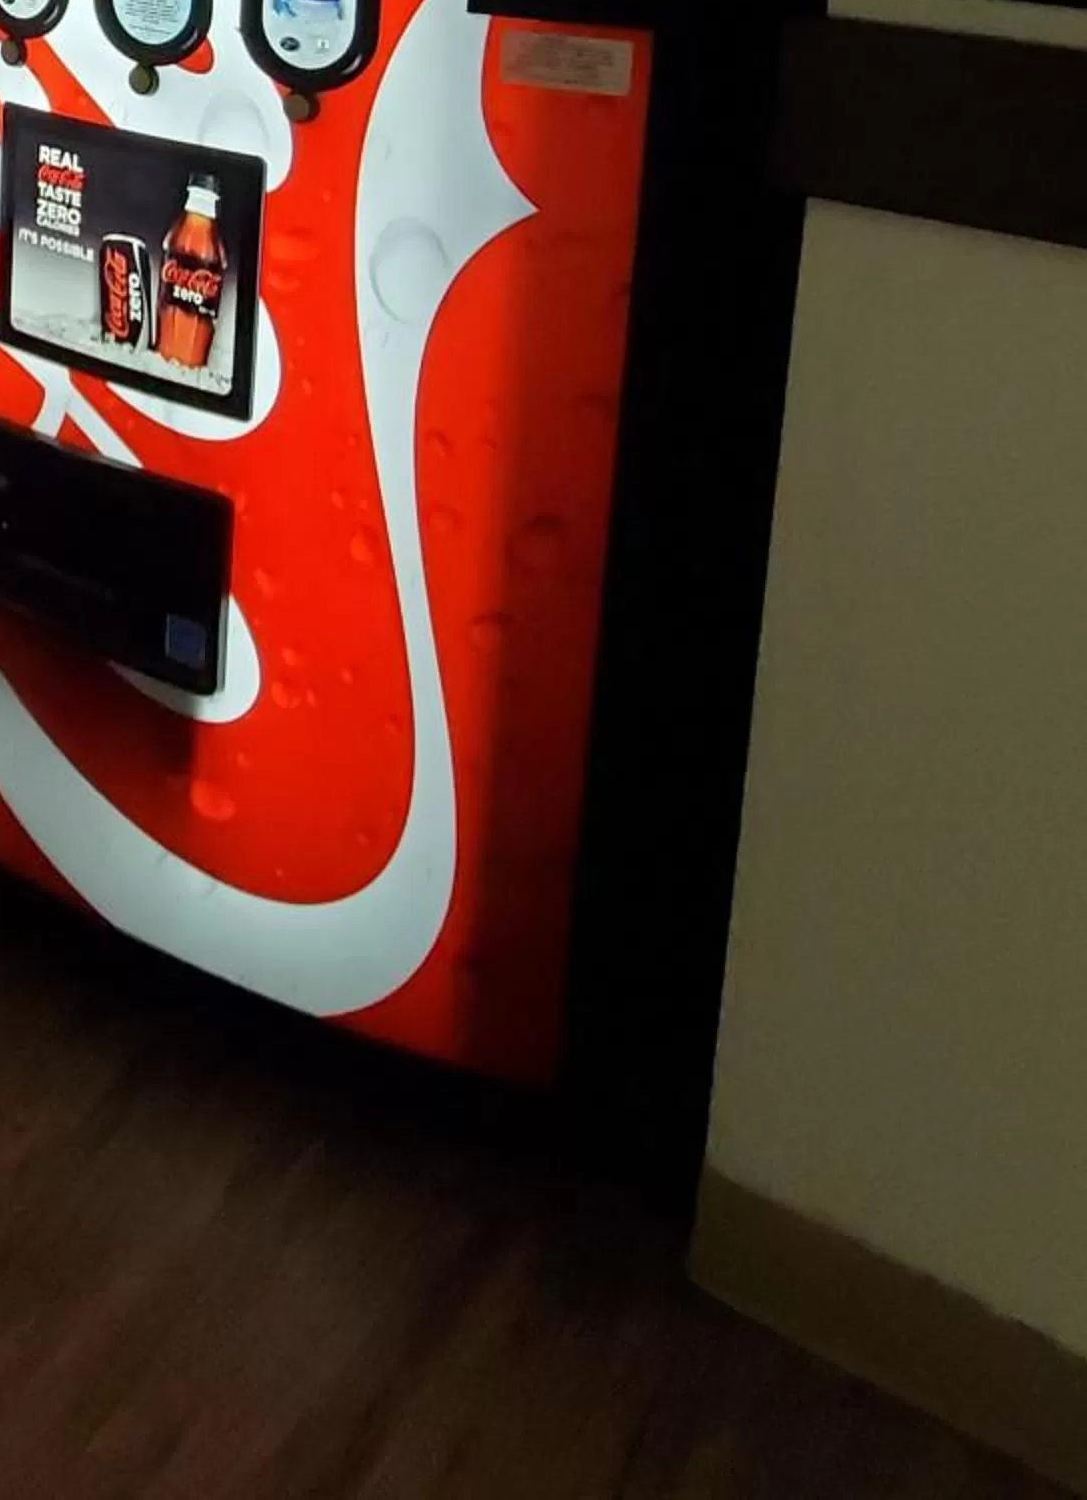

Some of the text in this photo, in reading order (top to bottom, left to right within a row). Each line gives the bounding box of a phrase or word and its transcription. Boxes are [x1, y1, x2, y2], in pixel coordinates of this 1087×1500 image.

[39, 144, 84, 174] REAL
[37, 181, 82, 207] TASTE
[36, 198, 82, 225] ZERO
[40, 234, 94, 262] POSSIBLE
[129, 272, 142, 321] zero
[172, 284, 204, 305] zero
